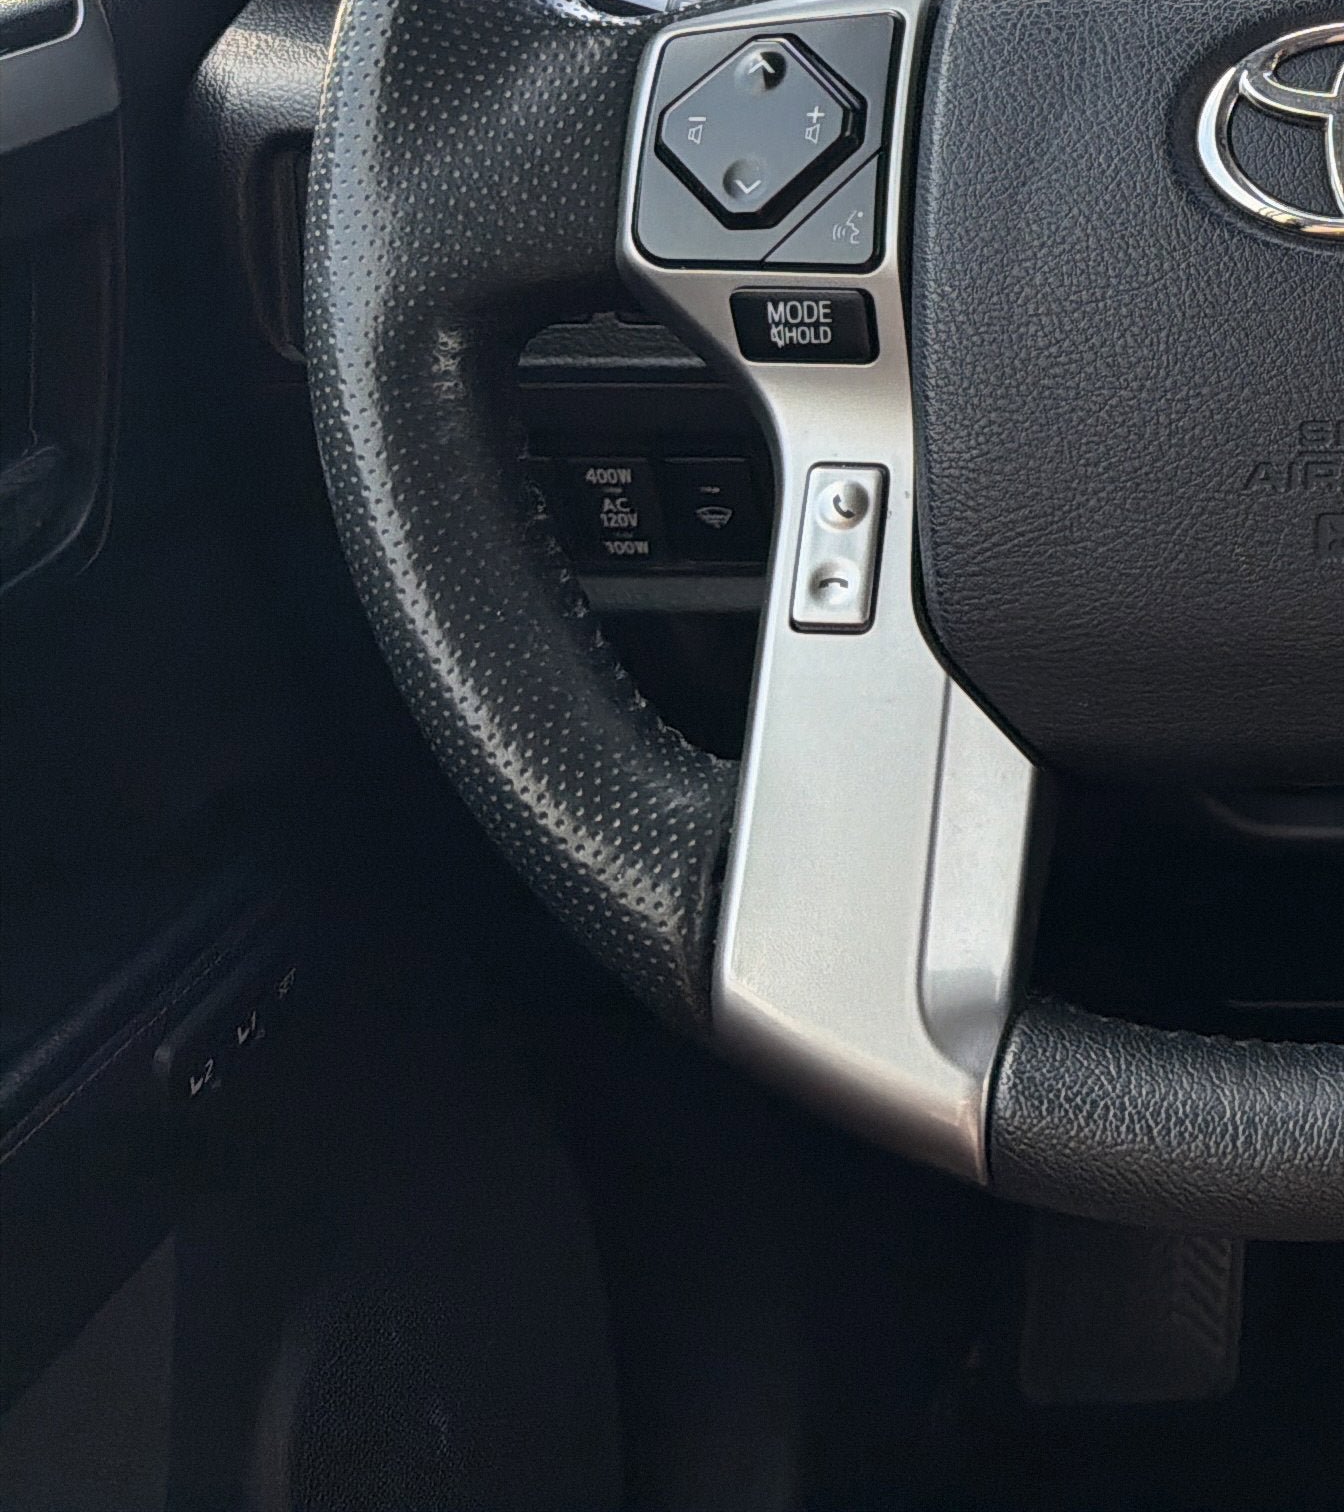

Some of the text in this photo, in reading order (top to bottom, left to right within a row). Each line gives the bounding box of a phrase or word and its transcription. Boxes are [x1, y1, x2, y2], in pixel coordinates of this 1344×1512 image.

[767, 301, 832, 324] MODE
[785, 326, 832, 345] HOLD
[585, 468, 632, 484] 400W
[603, 497, 630, 513] AC
[600, 512, 638, 528] 120V
